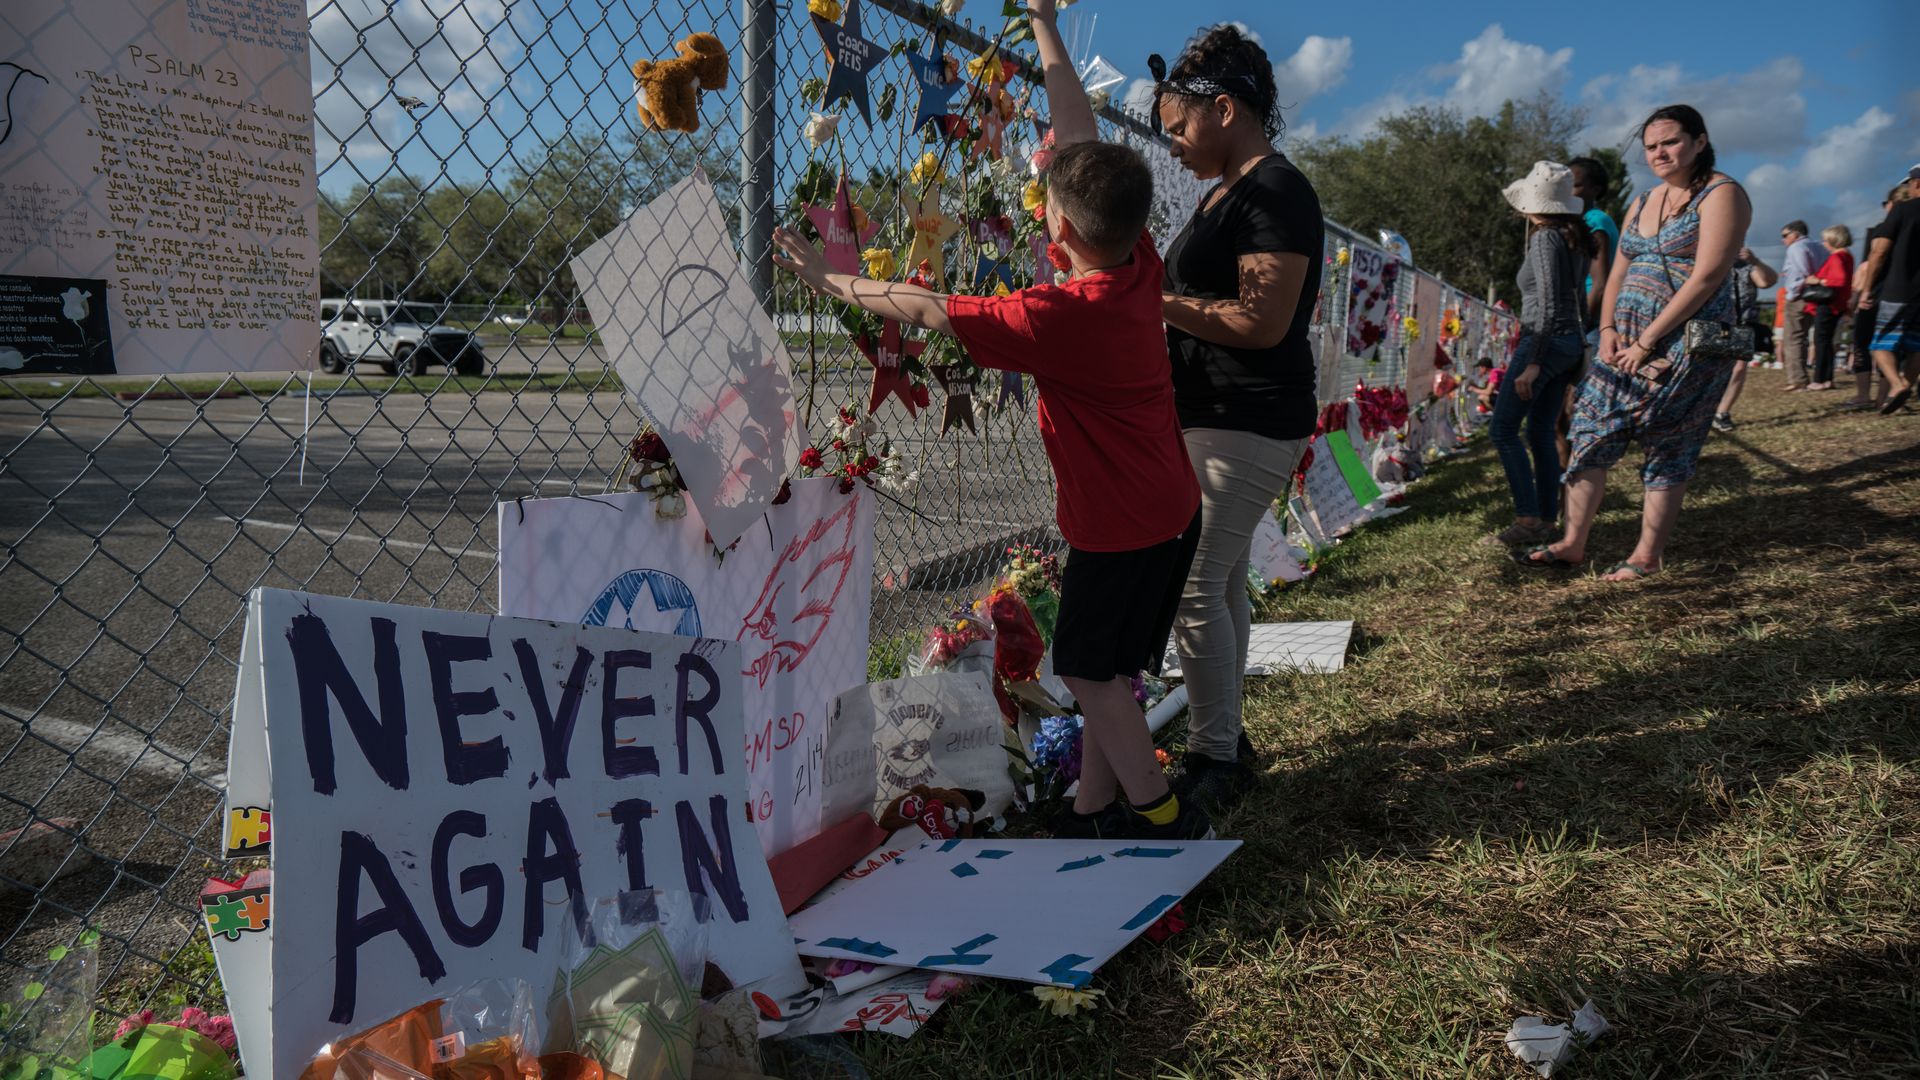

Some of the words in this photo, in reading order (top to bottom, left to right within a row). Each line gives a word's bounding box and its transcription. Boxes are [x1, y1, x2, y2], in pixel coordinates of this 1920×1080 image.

[128, 44, 206, 81] PSALM
[215, 68, 239, 87] 23
[838, 48, 862, 73] FEIS
[84, 70, 111, 84] The
[116, 73, 148, 91] Lord
[155, 81, 168, 95] is
[248, 103, 258, 114] I
[261, 104, 284, 119] shall
[287, 113, 308, 124] not
[80, 96, 91, 104] 2.
[93, 94, 111, 107] He
[116, 102, 175, 119] maketh
[180, 113, 197, 122] me
[200, 111, 212, 124] to
[216, 116, 231, 129] lie
[236, 119, 263, 133] down
[267, 128, 278, 136] in
[281, 132, 310, 146] green
[101, 117, 130, 132] Still
[134, 126, 184, 141] waters.
[160, 117, 182, 131] he
[184, 121, 229, 140] leadeth
[232, 134, 250, 143] me
[251, 132, 292, 151] beside
[295, 142, 312, 155] the
[87, 128, 99, 137] 3.
[98, 129, 117, 142] He
[183, 146, 205, 163] my
[238, 151, 255, 167] he
[259, 156, 305, 177] leadeth
[101, 154, 122, 166] for
[127, 158, 149, 171] his
[101, 144, 120, 156] me
[125, 149, 137, 157] in
[141, 148, 161, 161] the
[167, 153, 202, 169] paths
[207, 162, 219, 178] of
[222, 165, 301, 187] righteousness
[93, 165, 104, 175] 4.
[135, 172, 178, 189] though
[180, 180, 193, 191] I
[195, 184, 227, 198] walk
[229, 188, 273, 205] through
[278, 195, 297, 207] the
[149, 186, 166, 196] of
[167, 187, 188, 200] the
[194, 192, 240, 206] shadow
[243, 202, 255, 214] of
[105, 189, 119, 200] I
[152, 196, 181, 206] fear
[184, 203, 199, 212] no
[237, 208, 254, 219] for
[257, 209, 282, 222] thou
[286, 214, 305, 226] art
[109, 202, 144, 214] with
[179, 209, 200, 226] thy
[206, 215, 226, 227] rod
[231, 218, 250, 230] and
[254, 221, 272, 237] thy
[276, 225, 308, 238] staff
[111, 212, 137, 230] they
[208, 227, 235, 240] me.
[826, 217, 863, 245] Alain
[97, 228, 110, 239] 5.
[111, 229, 146, 242] Thou
[152, 238, 219, 252] preparest
[225, 246, 234, 256] a
[238, 242, 266, 257] table
[271, 245, 305, 260] before
[115, 242, 136, 251] me
[142, 242, 157, 253] in
[161, 245, 183, 256] the
[188, 252, 243, 263] presence
[249, 255, 260, 266] of
[262, 257, 290, 269] mine
[115, 263, 147, 274] with
[178, 270, 196, 284] my
[202, 272, 224, 286] cup
[229, 275, 278, 286] runneth
[181, 256, 208, 270] thou
[214, 262, 270, 275] anointest
[274, 267, 287, 280] my
[291, 266, 314, 279] head
[119, 278, 162, 295] Surely
[168, 283, 224, 298] goodness
[230, 286, 250, 297] and
[257, 290, 294, 304] mercy
[297, 289, 319, 301] shall
[121, 293, 165, 306] follow
[171, 299, 189, 307] me
[196, 297, 214, 308] the
[222, 297, 247, 310] days
[253, 299, 267, 309] of
[269, 301, 287, 316] my
[125, 305, 150, 317] and
[157, 308, 169, 318] I
[175, 308, 201, 317] will
[207, 308, 243, 320] dwell
[247, 309, 260, 319] in
[262, 309, 282, 320] the
[289, 308, 316, 323] house
[128, 317, 142, 329] of
[147, 319, 170, 329] the
[178, 318, 206, 330] Lord
[211, 320, 231, 329] for
[286, 613, 725, 798] NEVER
[745, 712, 805, 773] MSD
[922, 811, 944, 841] LOVE
[329, 793, 750, 1026] AGAIN
